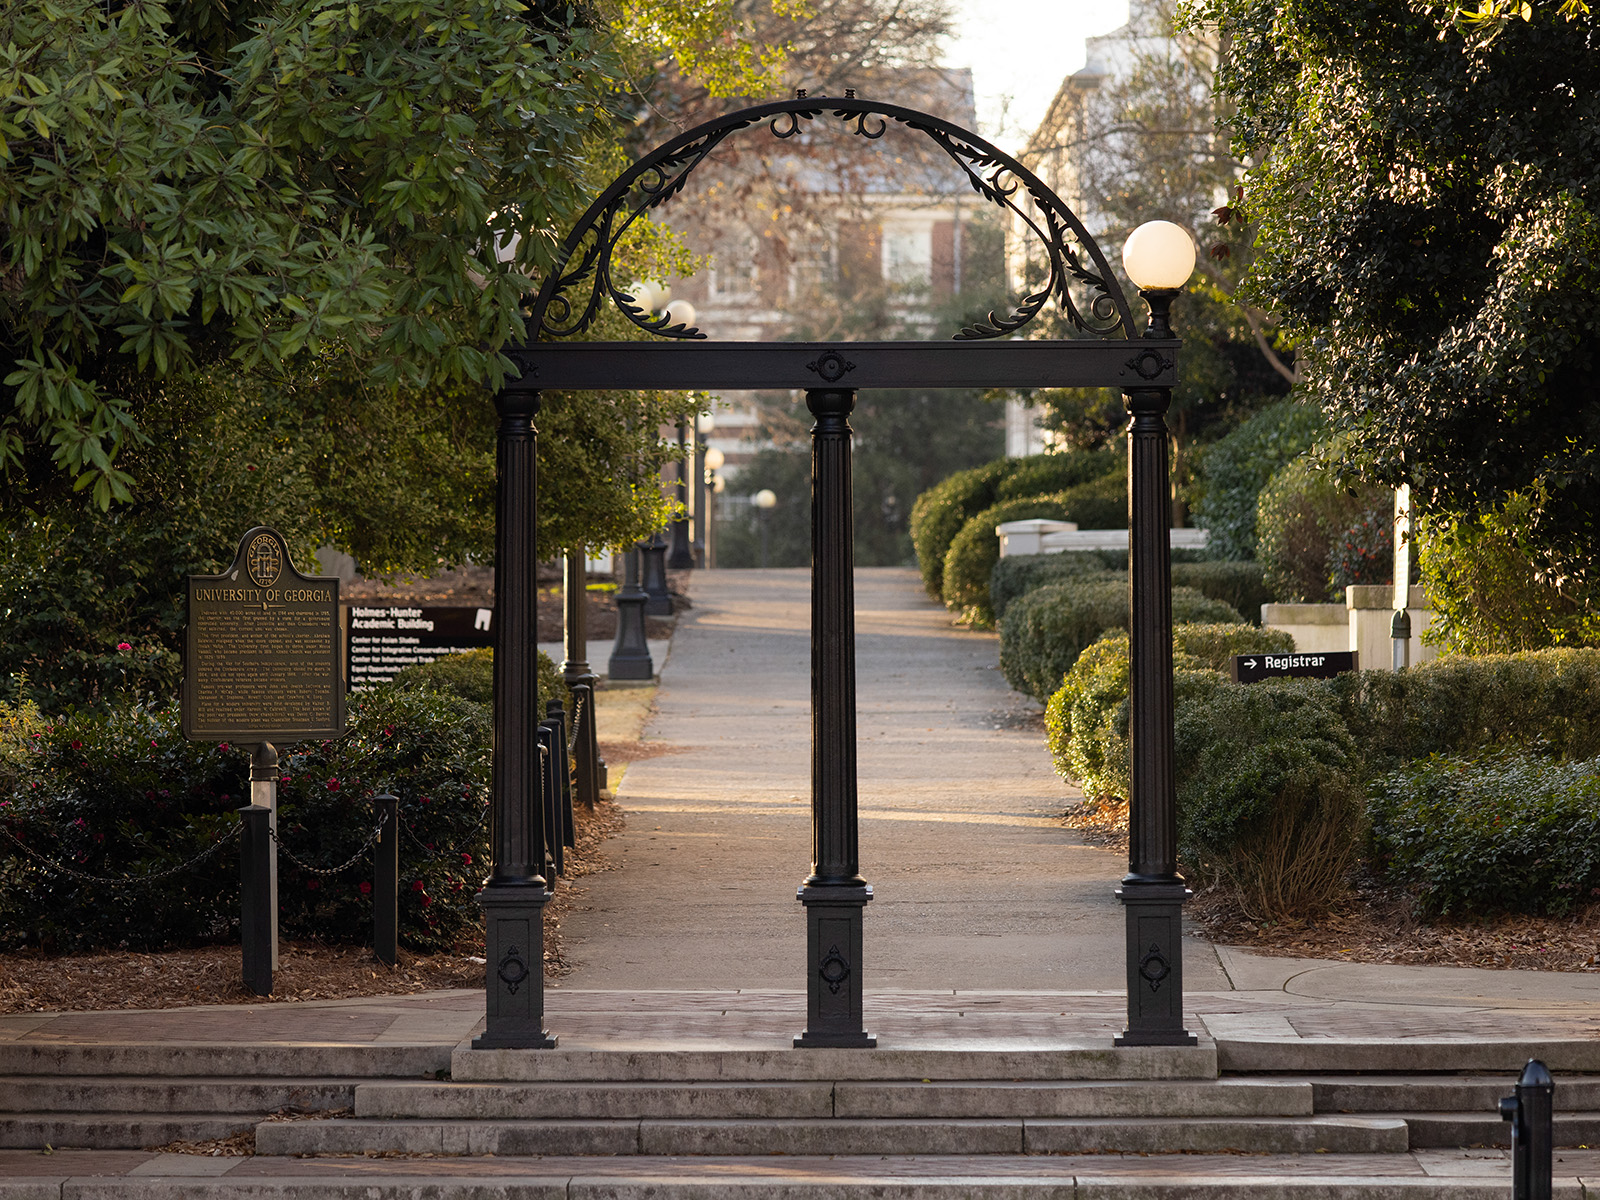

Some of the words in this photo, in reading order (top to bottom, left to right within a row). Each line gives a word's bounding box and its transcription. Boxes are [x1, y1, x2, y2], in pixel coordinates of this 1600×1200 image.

[250, 536, 280, 558] GEORGIA
[196, 588, 261, 602] UNIVERSITY
[266, 588, 280, 602] OF
[284, 590, 332, 602] GEORGIA
[352, 607, 423, 617] Holmes-Hunter
[352, 618, 396, 629] Academic
[397, 618, 434, 632] Building
[1264, 656, 1326, 670] Registrar
